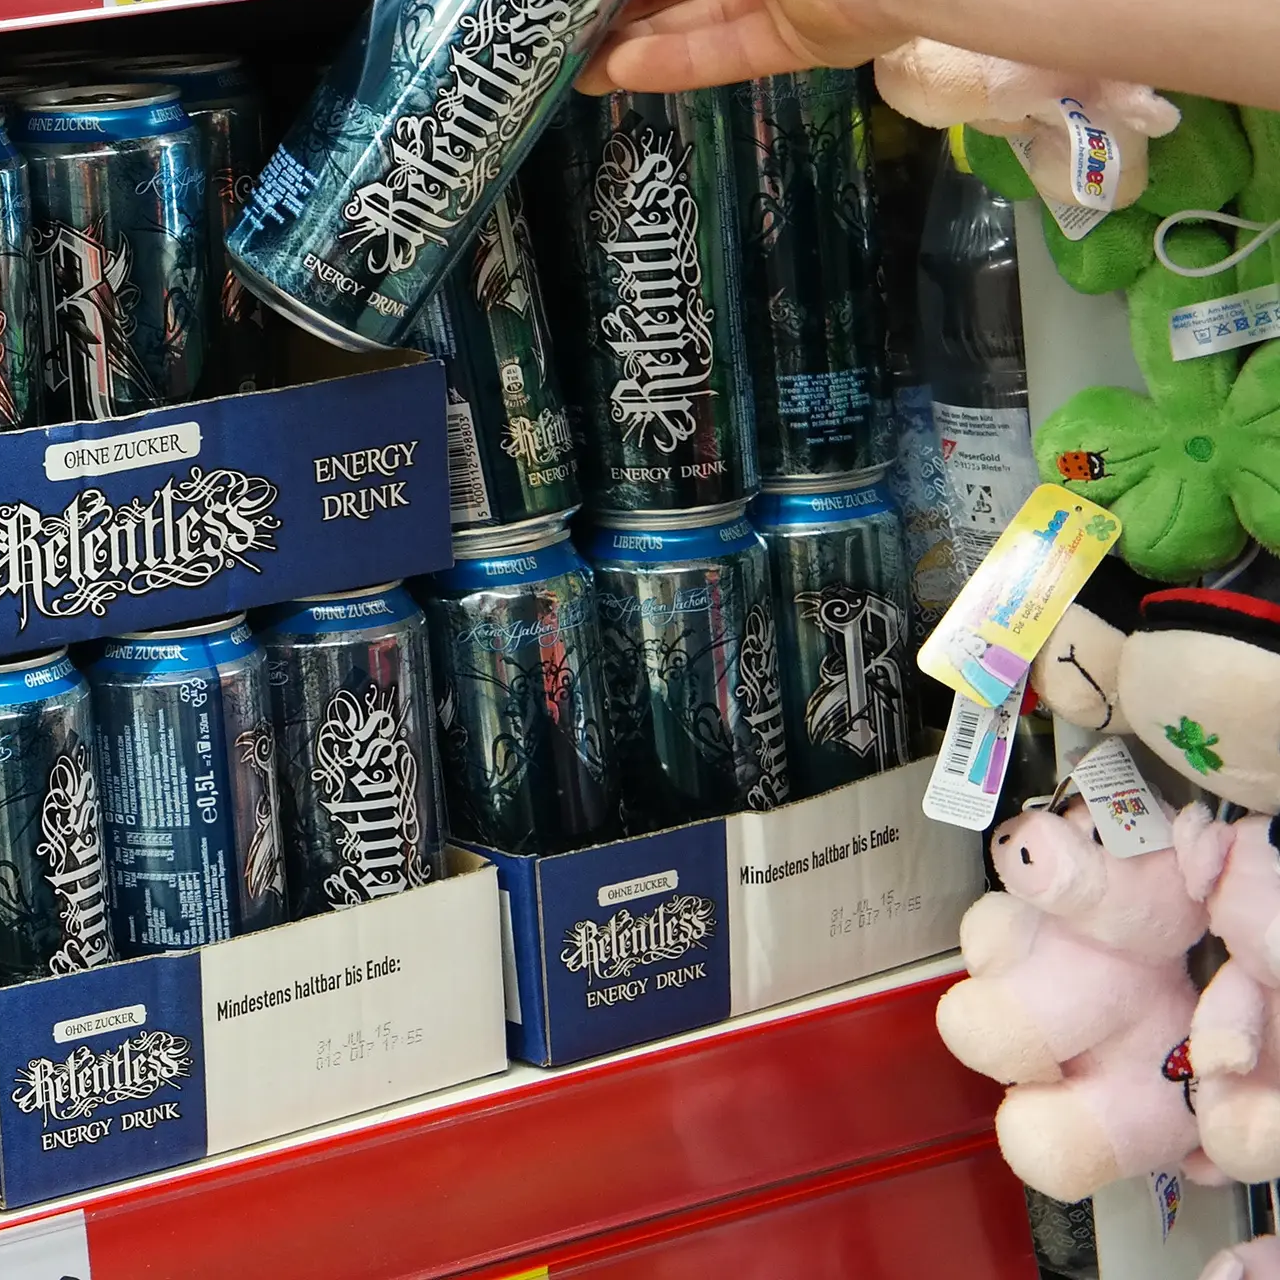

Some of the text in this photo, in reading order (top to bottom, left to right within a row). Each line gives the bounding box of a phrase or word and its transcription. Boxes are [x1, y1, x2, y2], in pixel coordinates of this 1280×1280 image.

[302, 253, 409, 317] ENERGY DRINK
[63, 433, 189, 471] OHNE ZUCKER
[313, 440, 421, 486] ENERGY
[610, 458, 728, 485] ENERGY DRINK
[322, 480, 412, 523] DRINK
[612, 533, 664, 553] LIBERTUS
[484, 556, 538, 577] LIBERTUS
[739, 827, 900, 888] Mindestens haltbar bis Ende:
[607, 876, 672, 902] OHNE ZUCKER
[560, 894, 718, 987] Relentless
[216, 955, 403, 1023] Mindestens haltbar bis Ende:
[586, 963, 707, 1010] ENERGY DRINK
[65, 1009, 140, 1039] OHNE ZUCKER
[13, 1030, 195, 1126] Relentless
[42, 1102, 181, 1152] ENERGY DRINK
